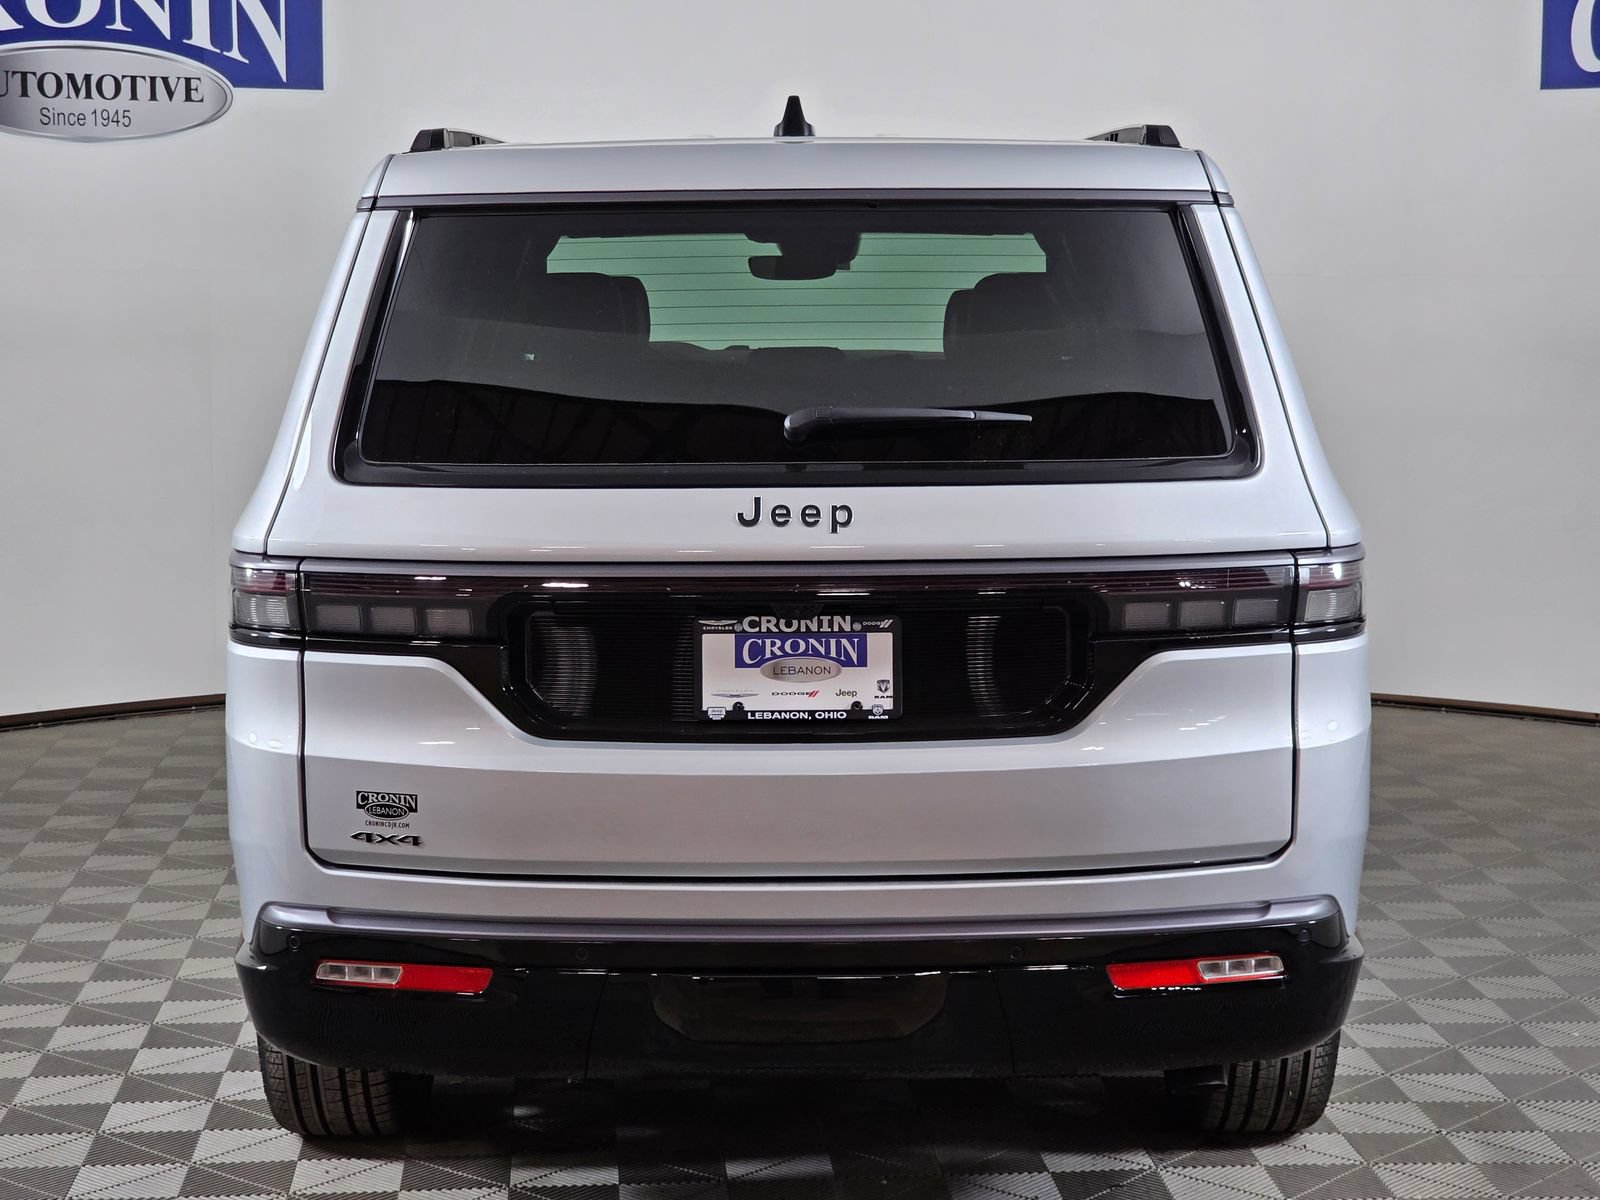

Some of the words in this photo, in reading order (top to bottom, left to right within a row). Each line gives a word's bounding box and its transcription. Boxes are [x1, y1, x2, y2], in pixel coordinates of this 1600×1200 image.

[0, 0, 287, 83] ONIN
[39, 107, 87, 127] Since
[91, 108, 132, 128] 1945
[735, 495, 855, 535] Jeep
[741, 615, 852, 633] CRONIN
[742, 638, 859, 666] CRONIN
[773, 665, 831, 676] LEBANON
[835, 689, 858, 698] Jeep
[747, 711, 812, 721] LEBANON,
[815, 711, 847, 720] OHIO
[357, 792, 416, 809] CRONIN
[368, 806, 405, 816] LEBANON
